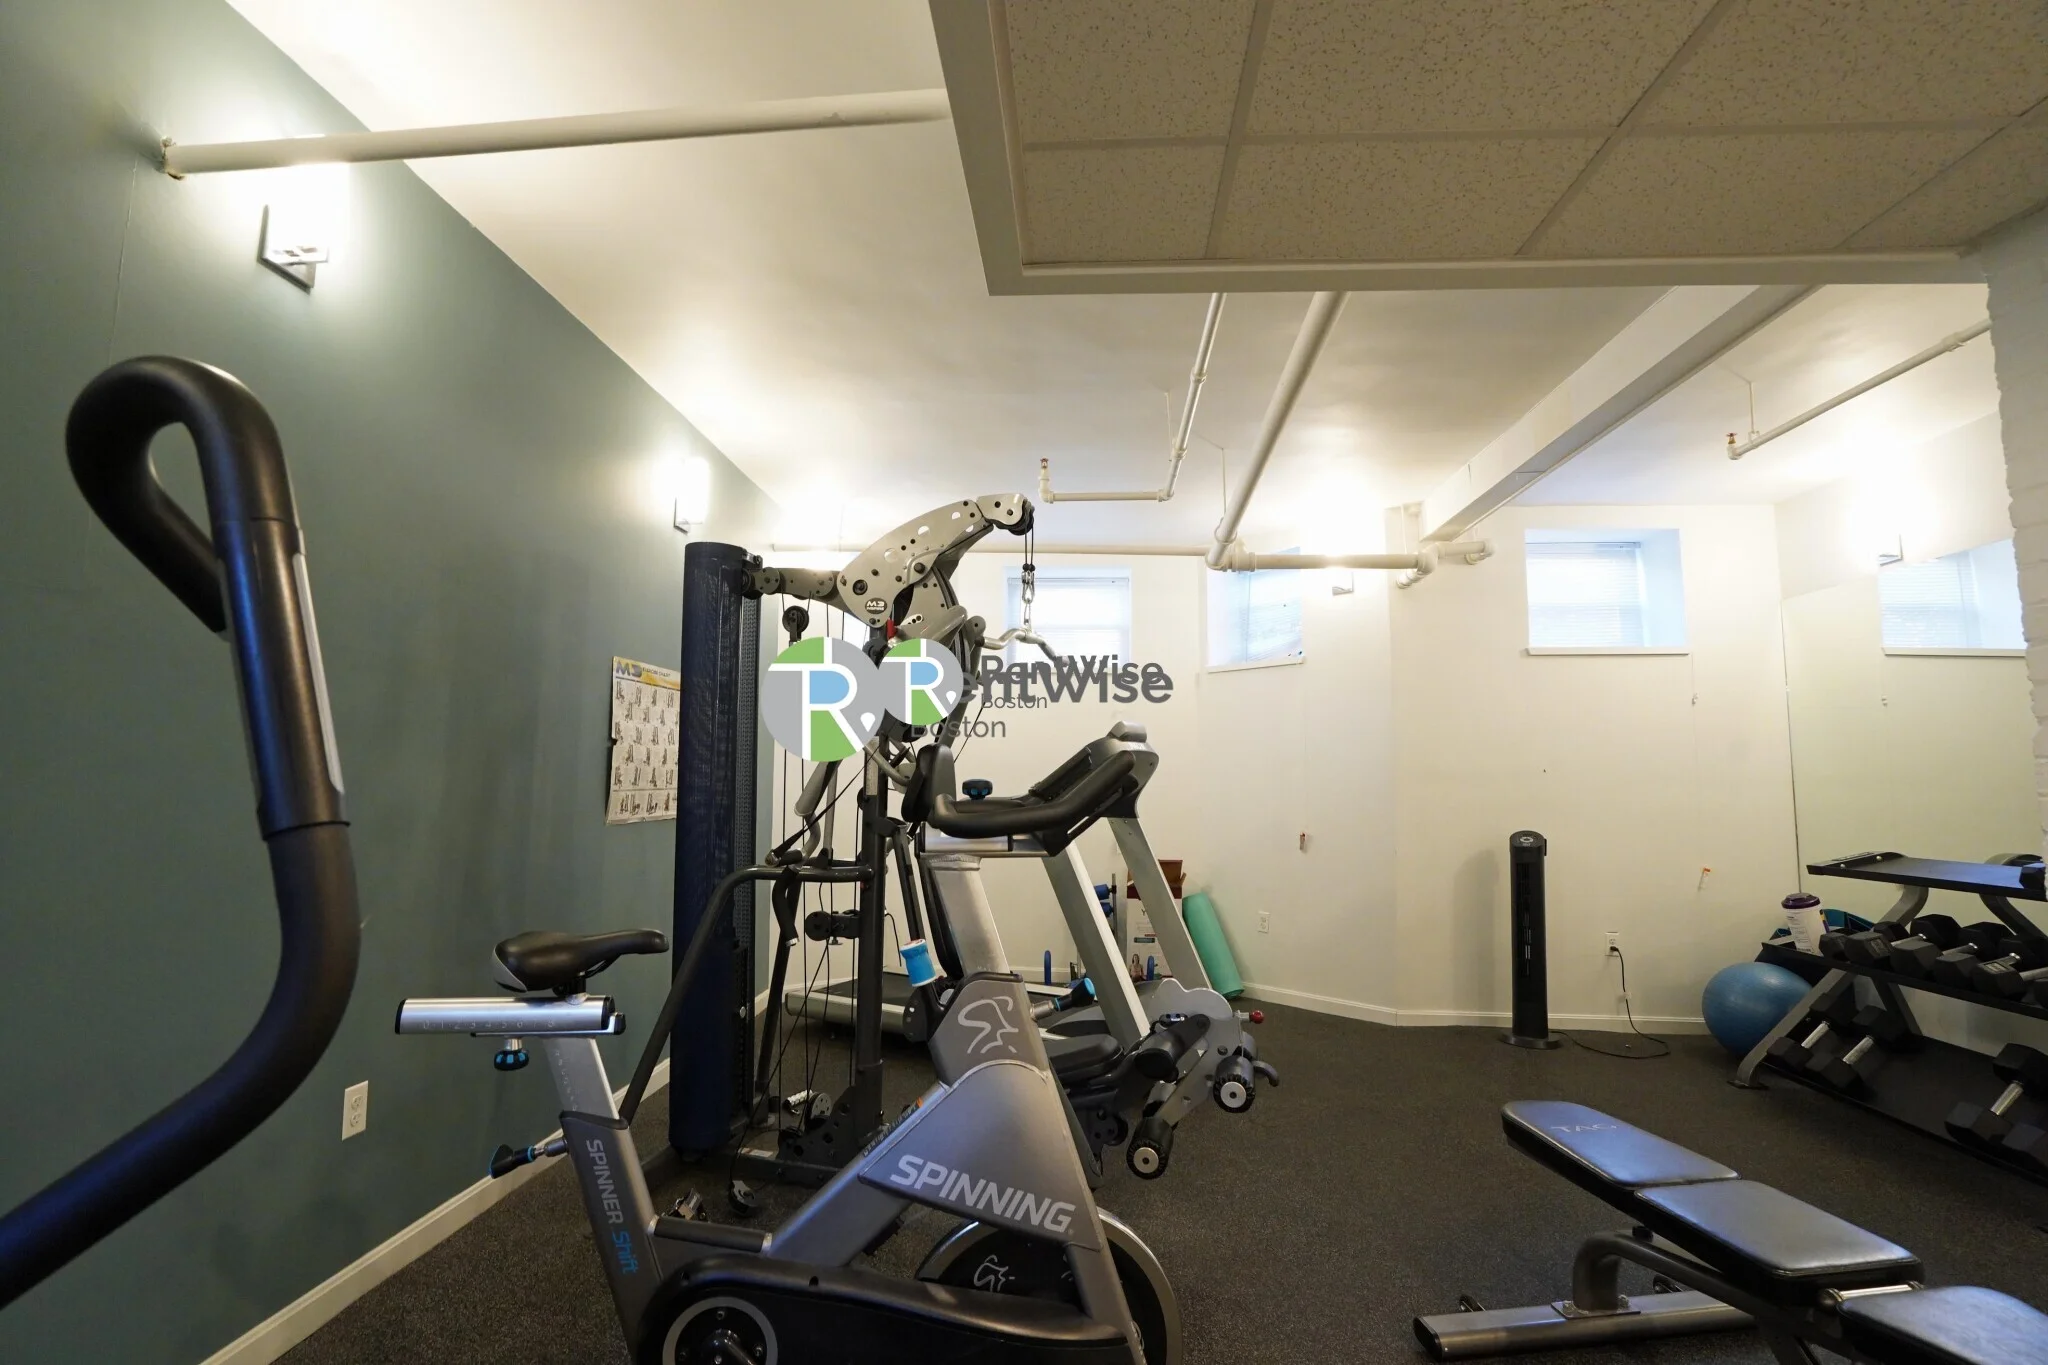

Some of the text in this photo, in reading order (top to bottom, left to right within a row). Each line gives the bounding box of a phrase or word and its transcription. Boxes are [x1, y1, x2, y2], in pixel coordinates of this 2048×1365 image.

[586, 1139, 639, 1275] SPINNER Shift
[890, 1154, 1076, 1234] SPINNING
